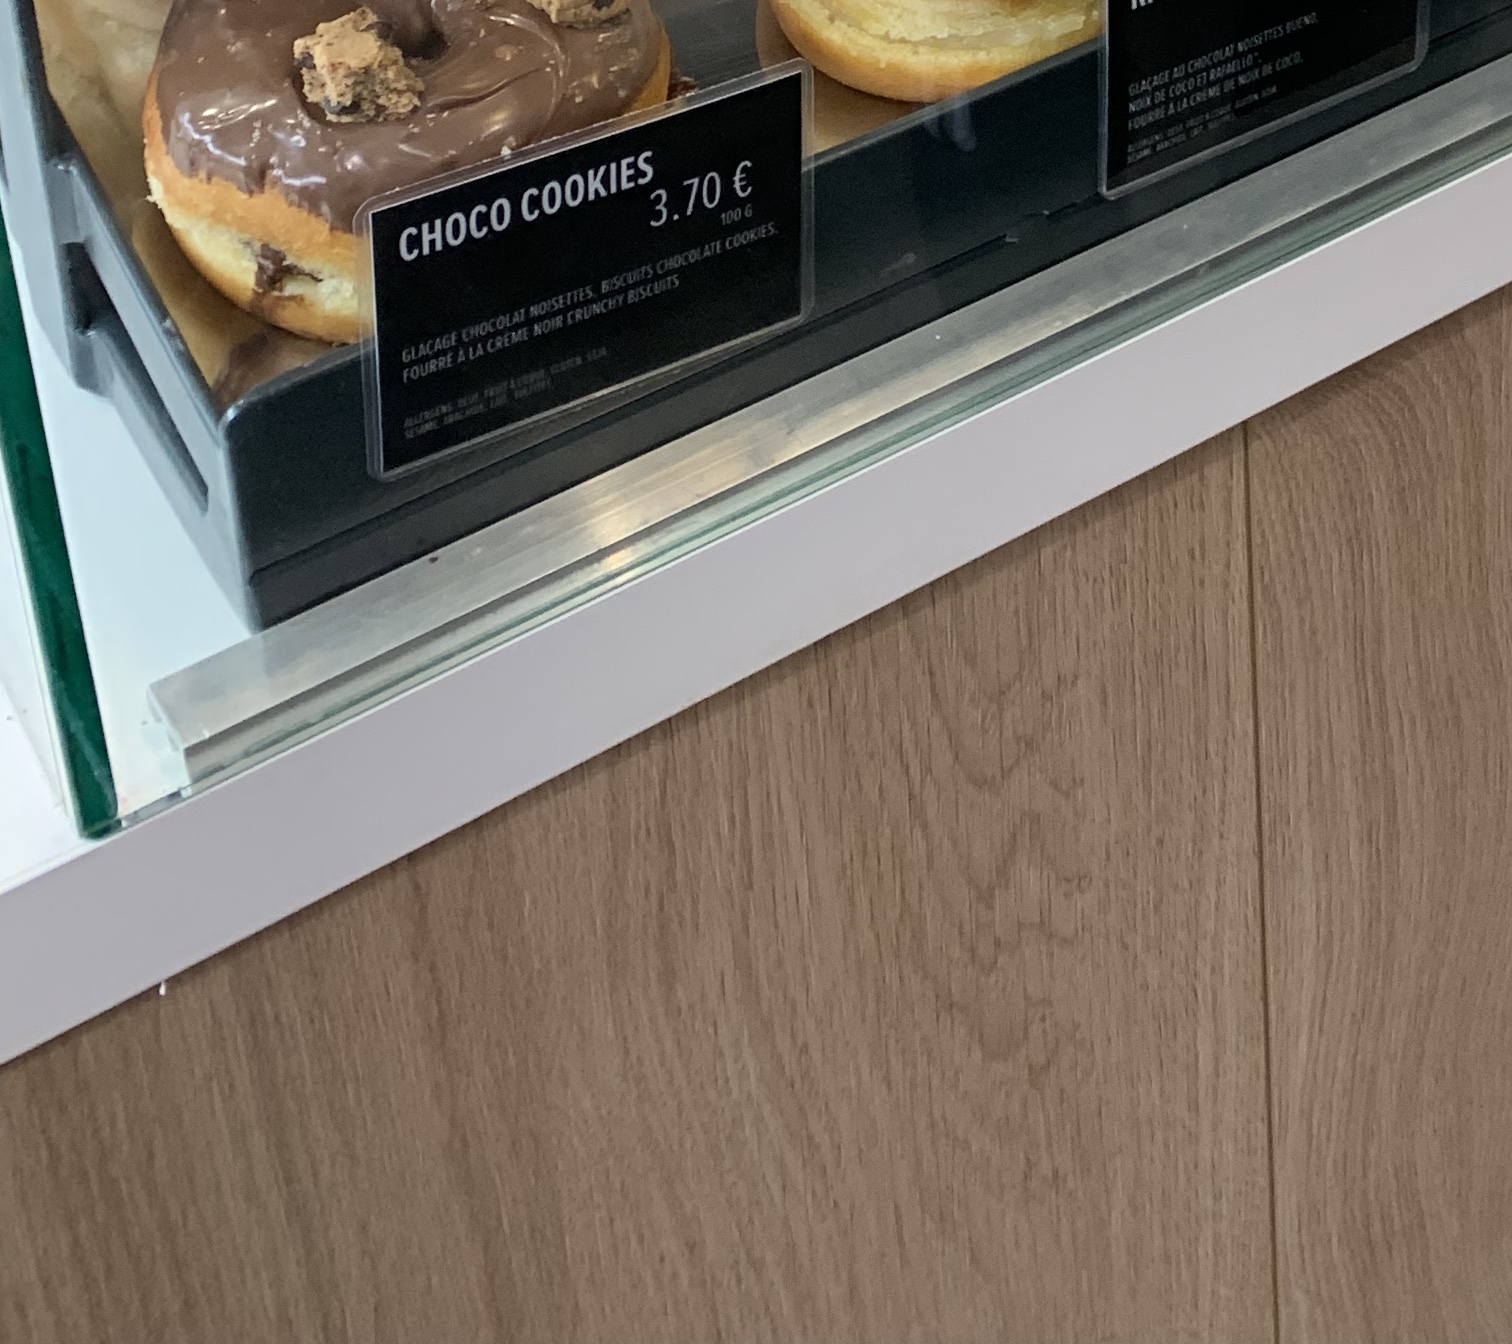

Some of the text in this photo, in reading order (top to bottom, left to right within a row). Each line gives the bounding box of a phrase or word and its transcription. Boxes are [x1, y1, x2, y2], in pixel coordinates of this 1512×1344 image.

[397, 146, 654, 266] CHOCO COOKIES
[649, 157, 753, 229] 3.70 €
[720, 202, 753, 227] 100 G
[656, 237, 722, 277] CHOCOLATE
[468, 339, 484, 362] LA
[531, 311, 564, 339] NOIR
[566, 290, 624, 327] CRUNCHY
